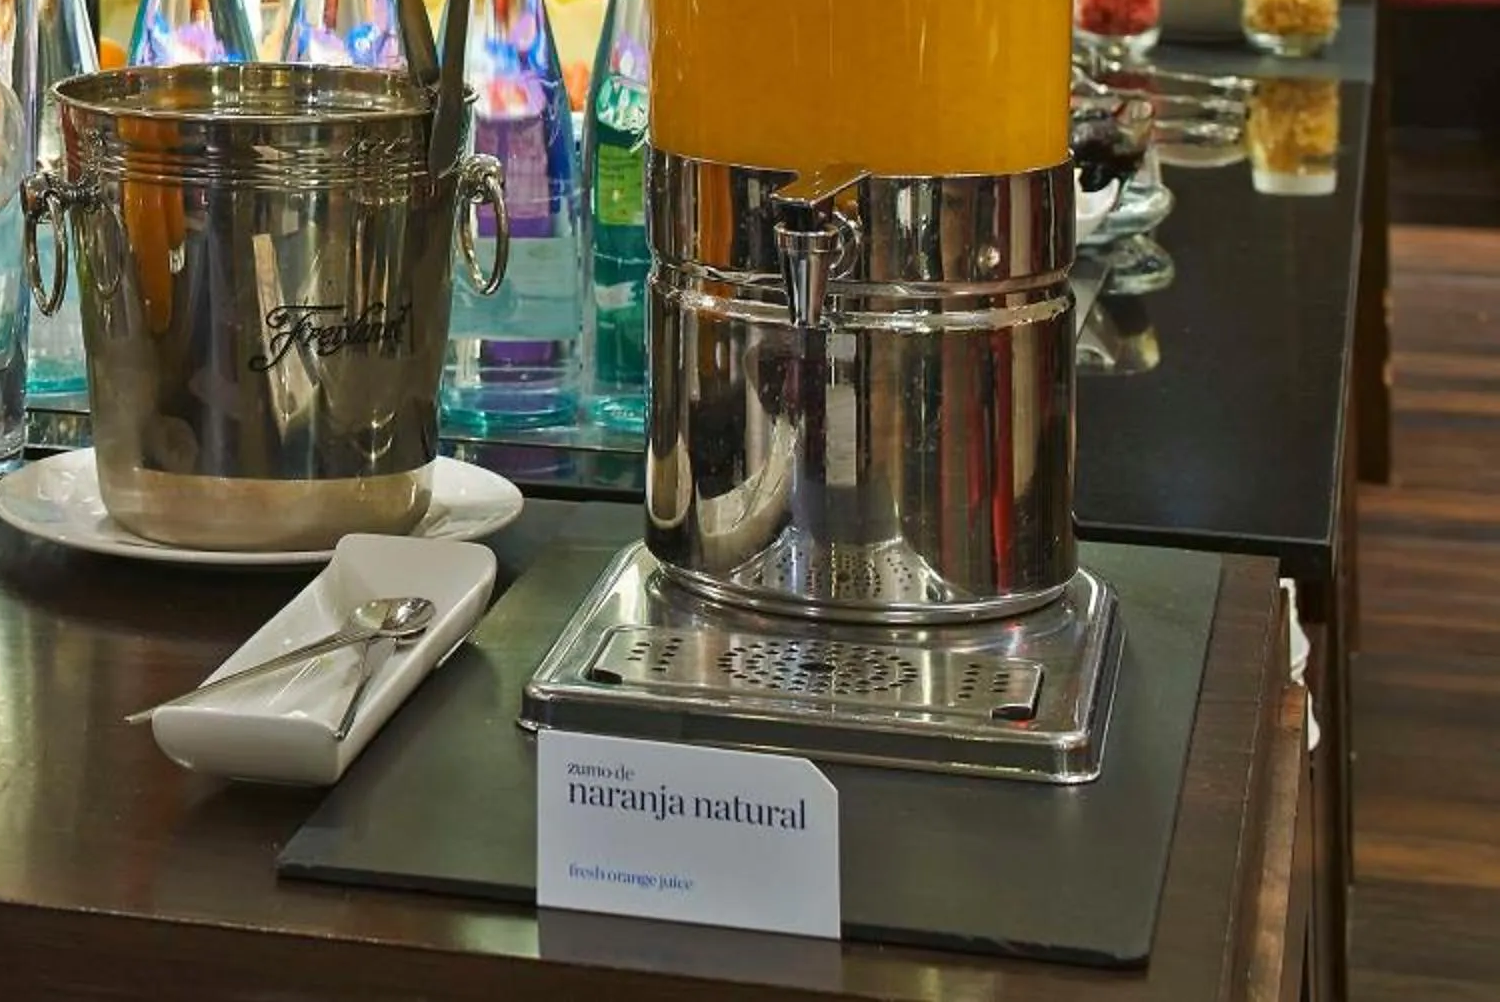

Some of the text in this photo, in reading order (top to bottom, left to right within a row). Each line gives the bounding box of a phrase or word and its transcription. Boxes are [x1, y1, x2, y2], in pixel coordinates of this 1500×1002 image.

[567, 761, 636, 782] zumo de
[567, 781, 807, 830] naranja natural
[568, 862, 695, 891] fresh orange juice
